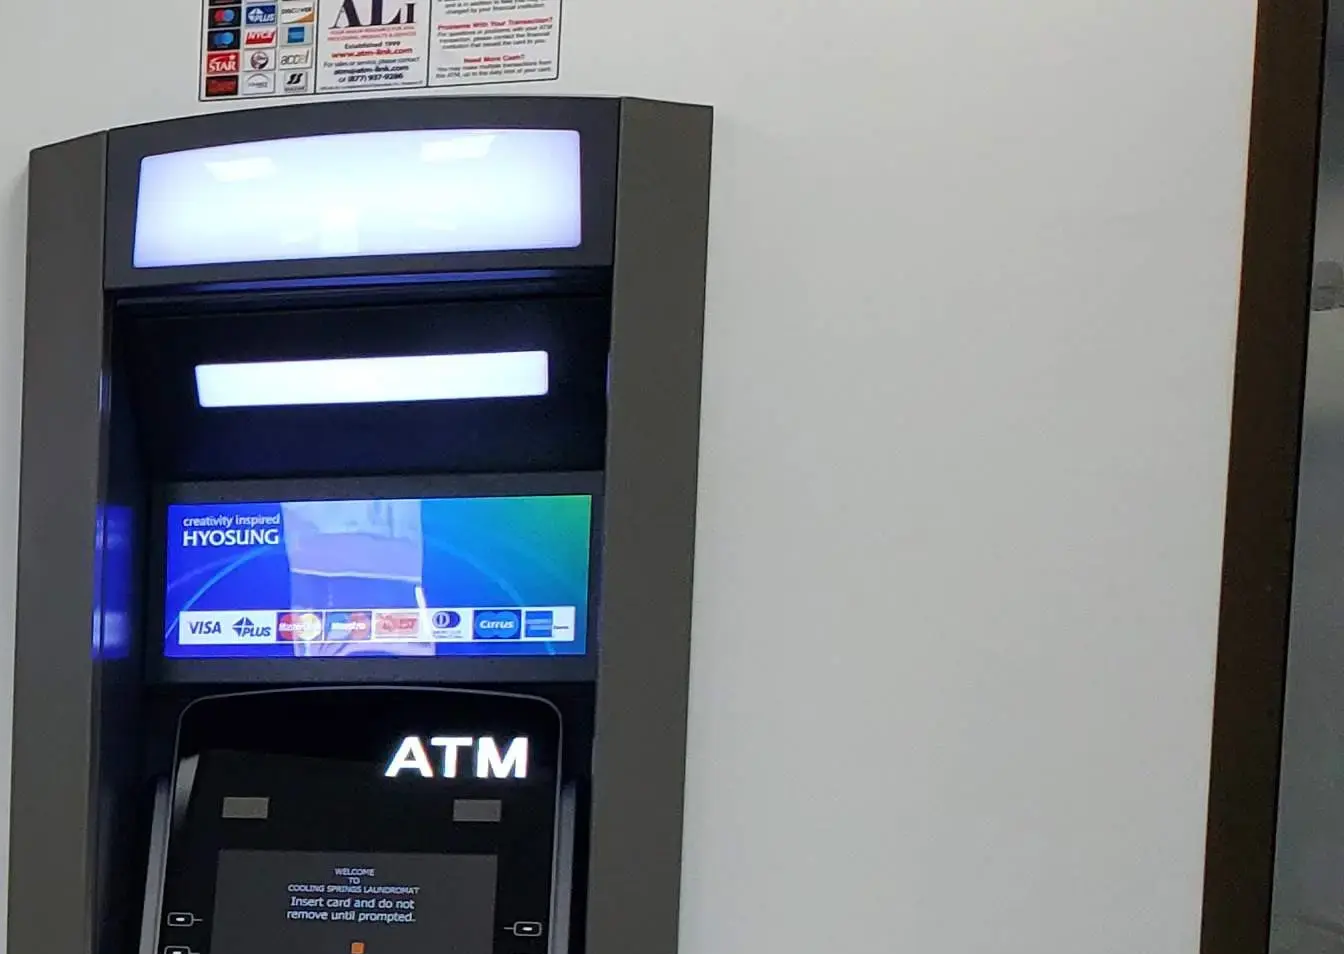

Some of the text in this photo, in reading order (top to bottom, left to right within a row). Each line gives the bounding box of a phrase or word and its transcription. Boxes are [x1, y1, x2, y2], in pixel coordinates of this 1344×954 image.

[256, 13, 274, 23] PLUS
[209, 59, 236, 72] STAR
[183, 513, 281, 528] creativity inspired
[183, 529, 279, 546] HYOSUNG
[189, 621, 222, 635] VISA
[242, 626, 272, 637] PLUS
[384, 736, 529, 778] ATM
[334, 868, 375, 876] WELCOME
[287, 884, 420, 895] COOLING SPRINGS LAUNDROMAT
[290, 896, 415, 910] Insert card and do not
[287, 910, 416, 923] remove until prompted.
